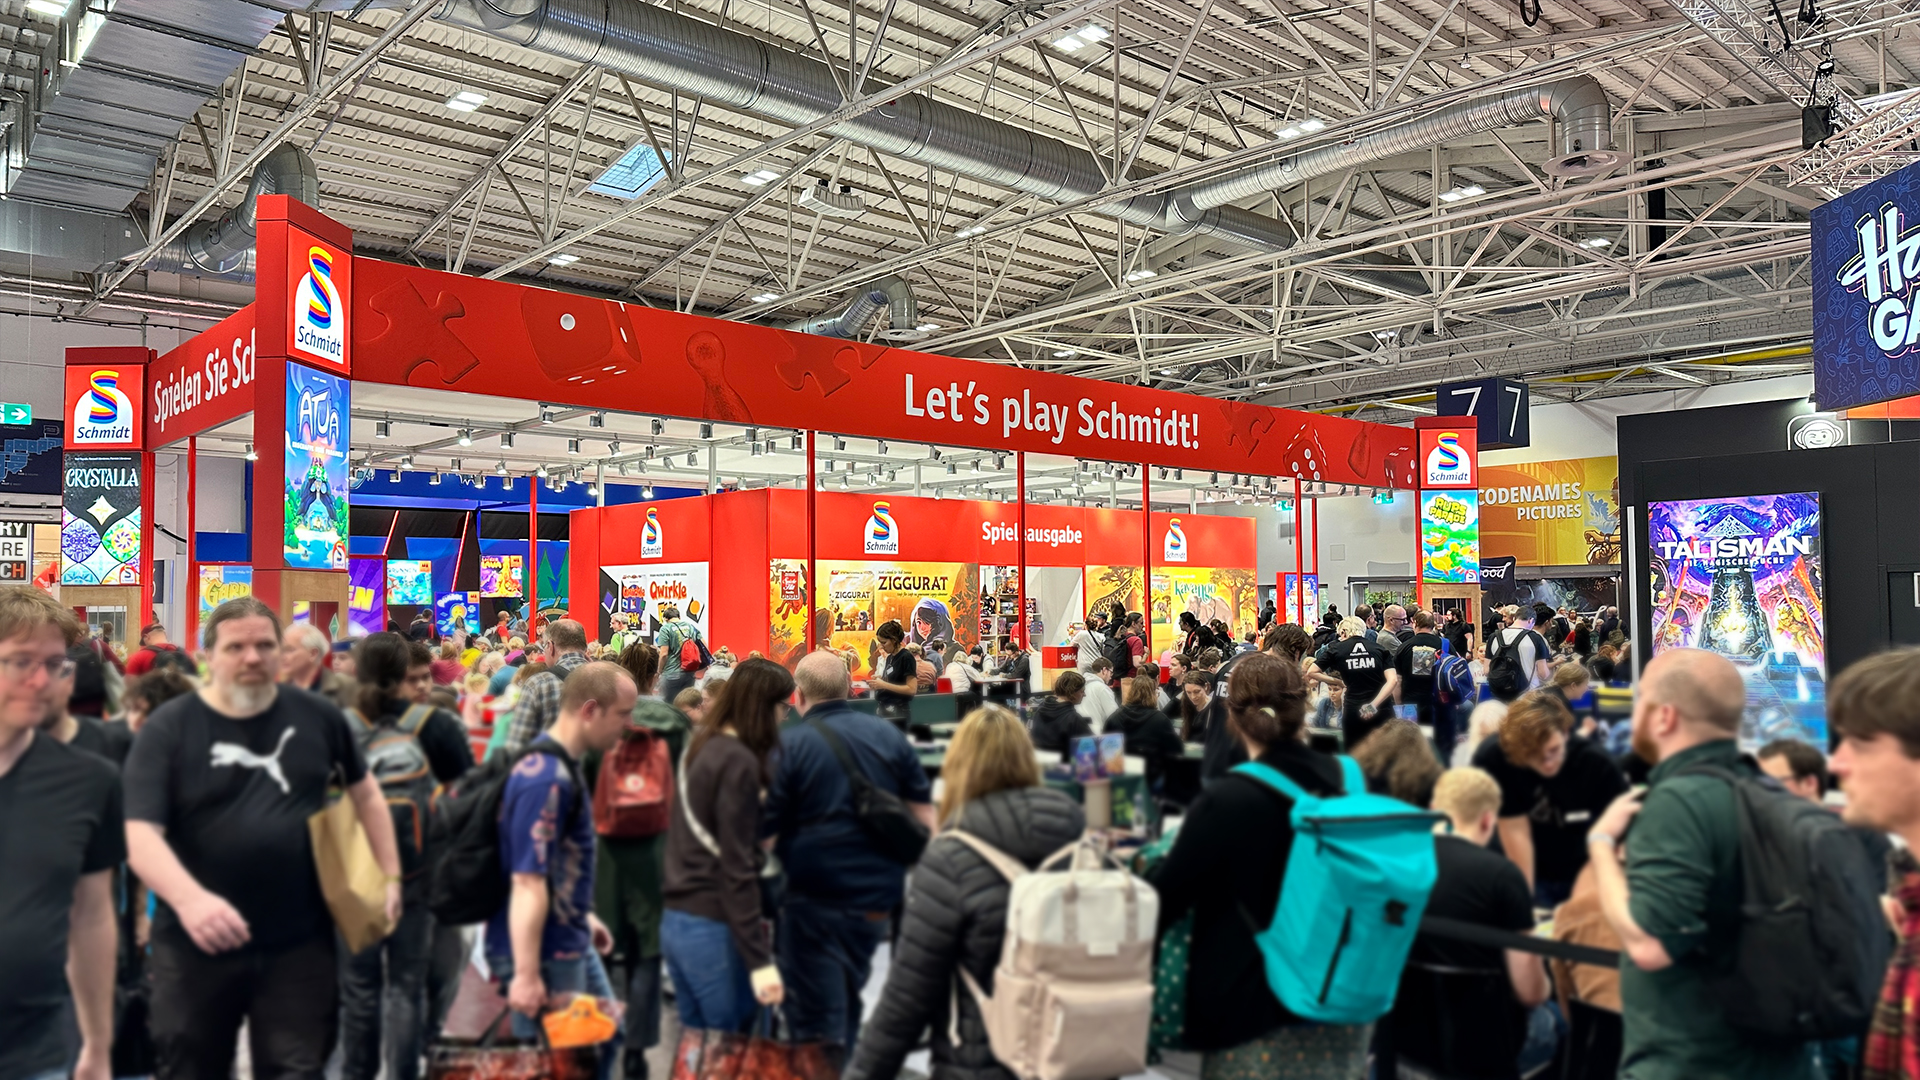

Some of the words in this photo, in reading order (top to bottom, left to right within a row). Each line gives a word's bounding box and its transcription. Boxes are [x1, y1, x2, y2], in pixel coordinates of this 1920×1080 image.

[297, 325, 342, 357] Schmidt
[153, 366, 202, 433] Spielen
[205, 347, 228, 402] Sie
[905, 373, 991, 425] Let’s
[1002, 389, 1069, 445] play
[1077, 398, 1199, 450] Schmidt!
[1451, 386, 1482, 416] 7
[297, 389, 341, 439] ATUA
[1505, 386, 1522, 438] 7
[76, 425, 131, 439] Schmidt
[65, 467, 139, 490] CRYSTALLA
[1429, 471, 1469, 481] Schmidt
[1428, 505, 1467, 525] PARADE
[1517, 503, 1583, 521] PICTURES
[981, 520, 1083, 548] Spielausgabe
[866, 541, 897, 551] Schmidt
[1657, 534, 1813, 561] TALISMAN
[1480, 561, 1512, 579] ood
[1683, 557, 1698, 567] DIE
[1754, 556, 1785, 566] SUCHE
[649, 579, 687, 601] Qwirkle
[877, 575, 949, 591] ZIGGURAT
[1174, 580, 1217, 605] kavango
[834, 591, 871, 599] ZIGGURAT
[1345, 657, 1376, 670] TEAM
[1215, 680, 1230, 698] TE
